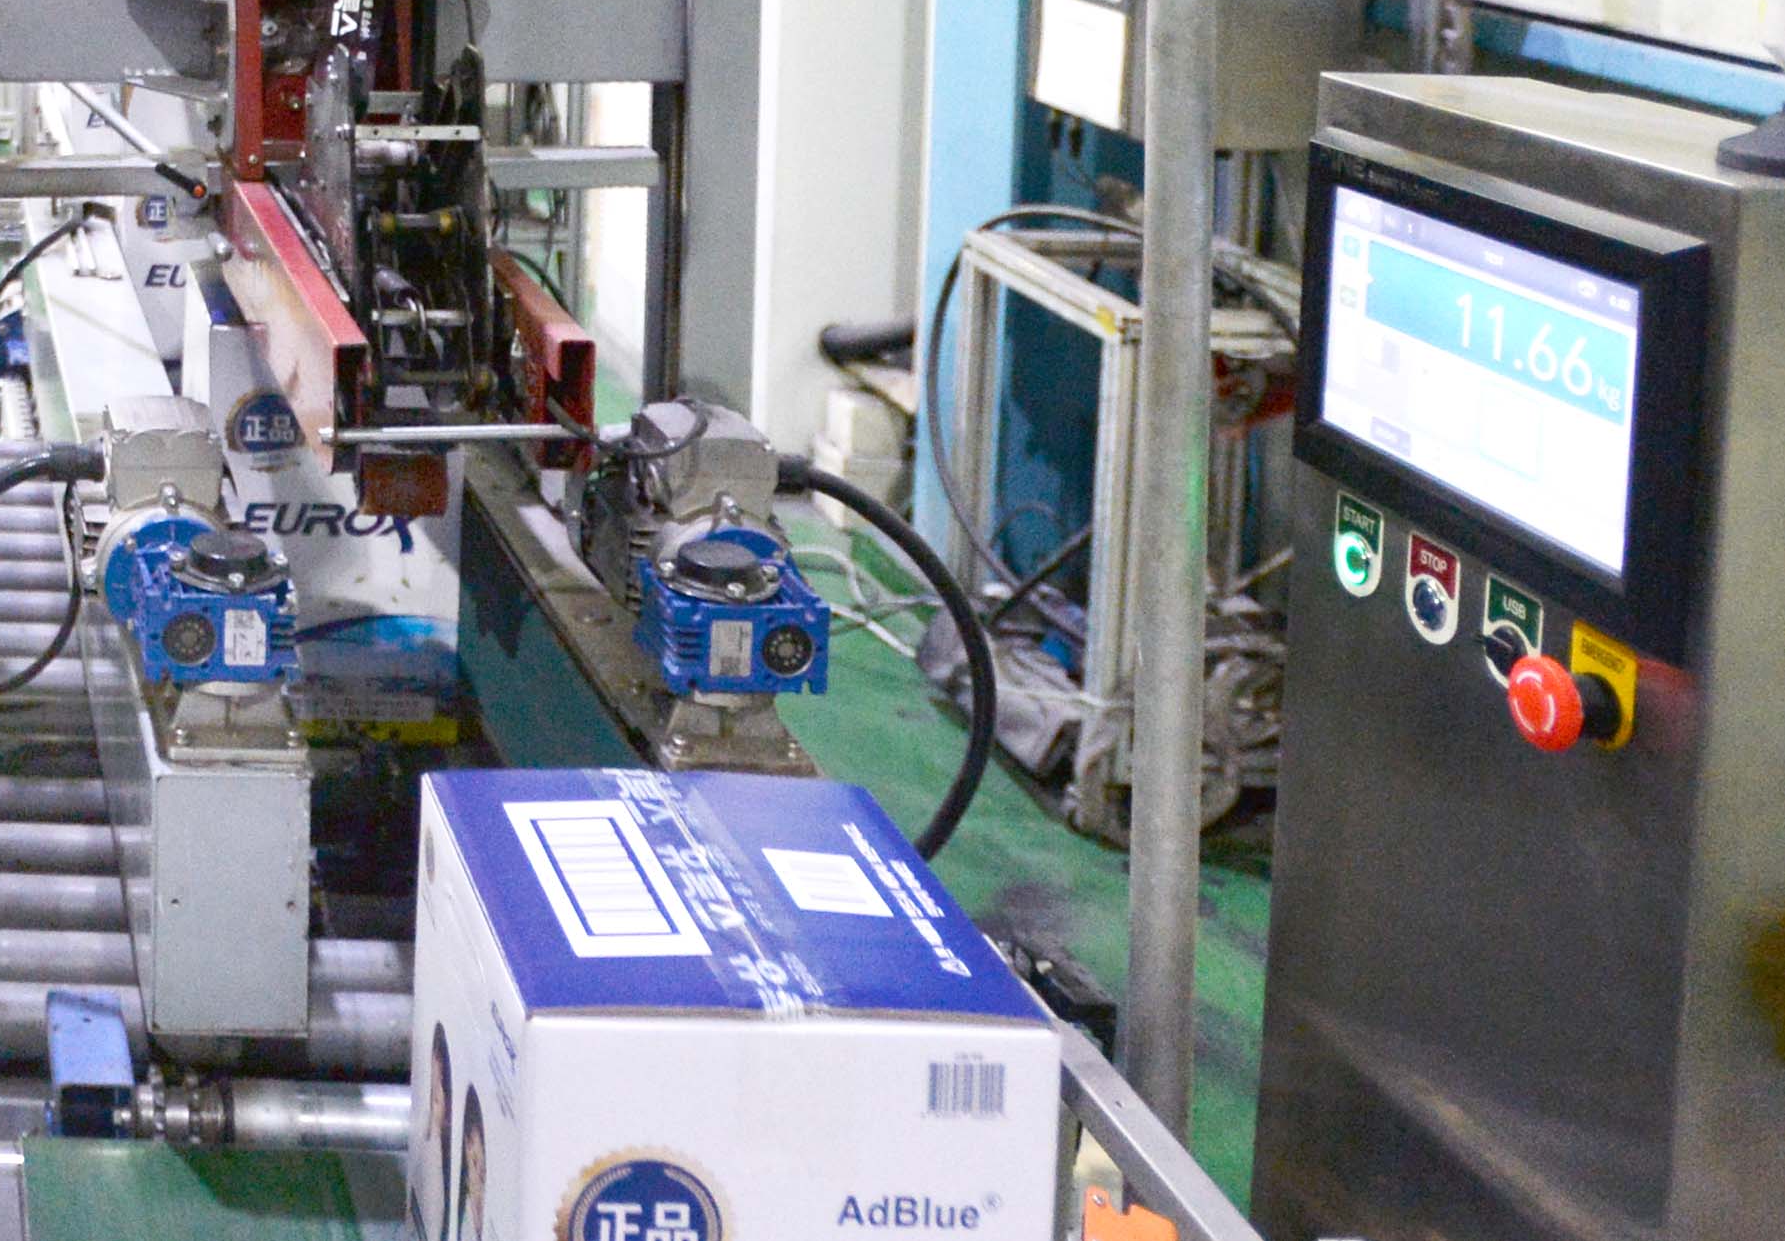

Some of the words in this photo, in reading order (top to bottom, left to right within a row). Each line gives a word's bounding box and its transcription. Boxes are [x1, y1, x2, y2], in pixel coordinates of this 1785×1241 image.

[1455, 292, 1594, 397] 11.66
[1597, 375, 1622, 412] kg
[242, 414, 296, 443] 正品
[1342, 505, 1375, 536] START
[1419, 550, 1448, 574] STOP
[1502, 595, 1527, 620] USB
